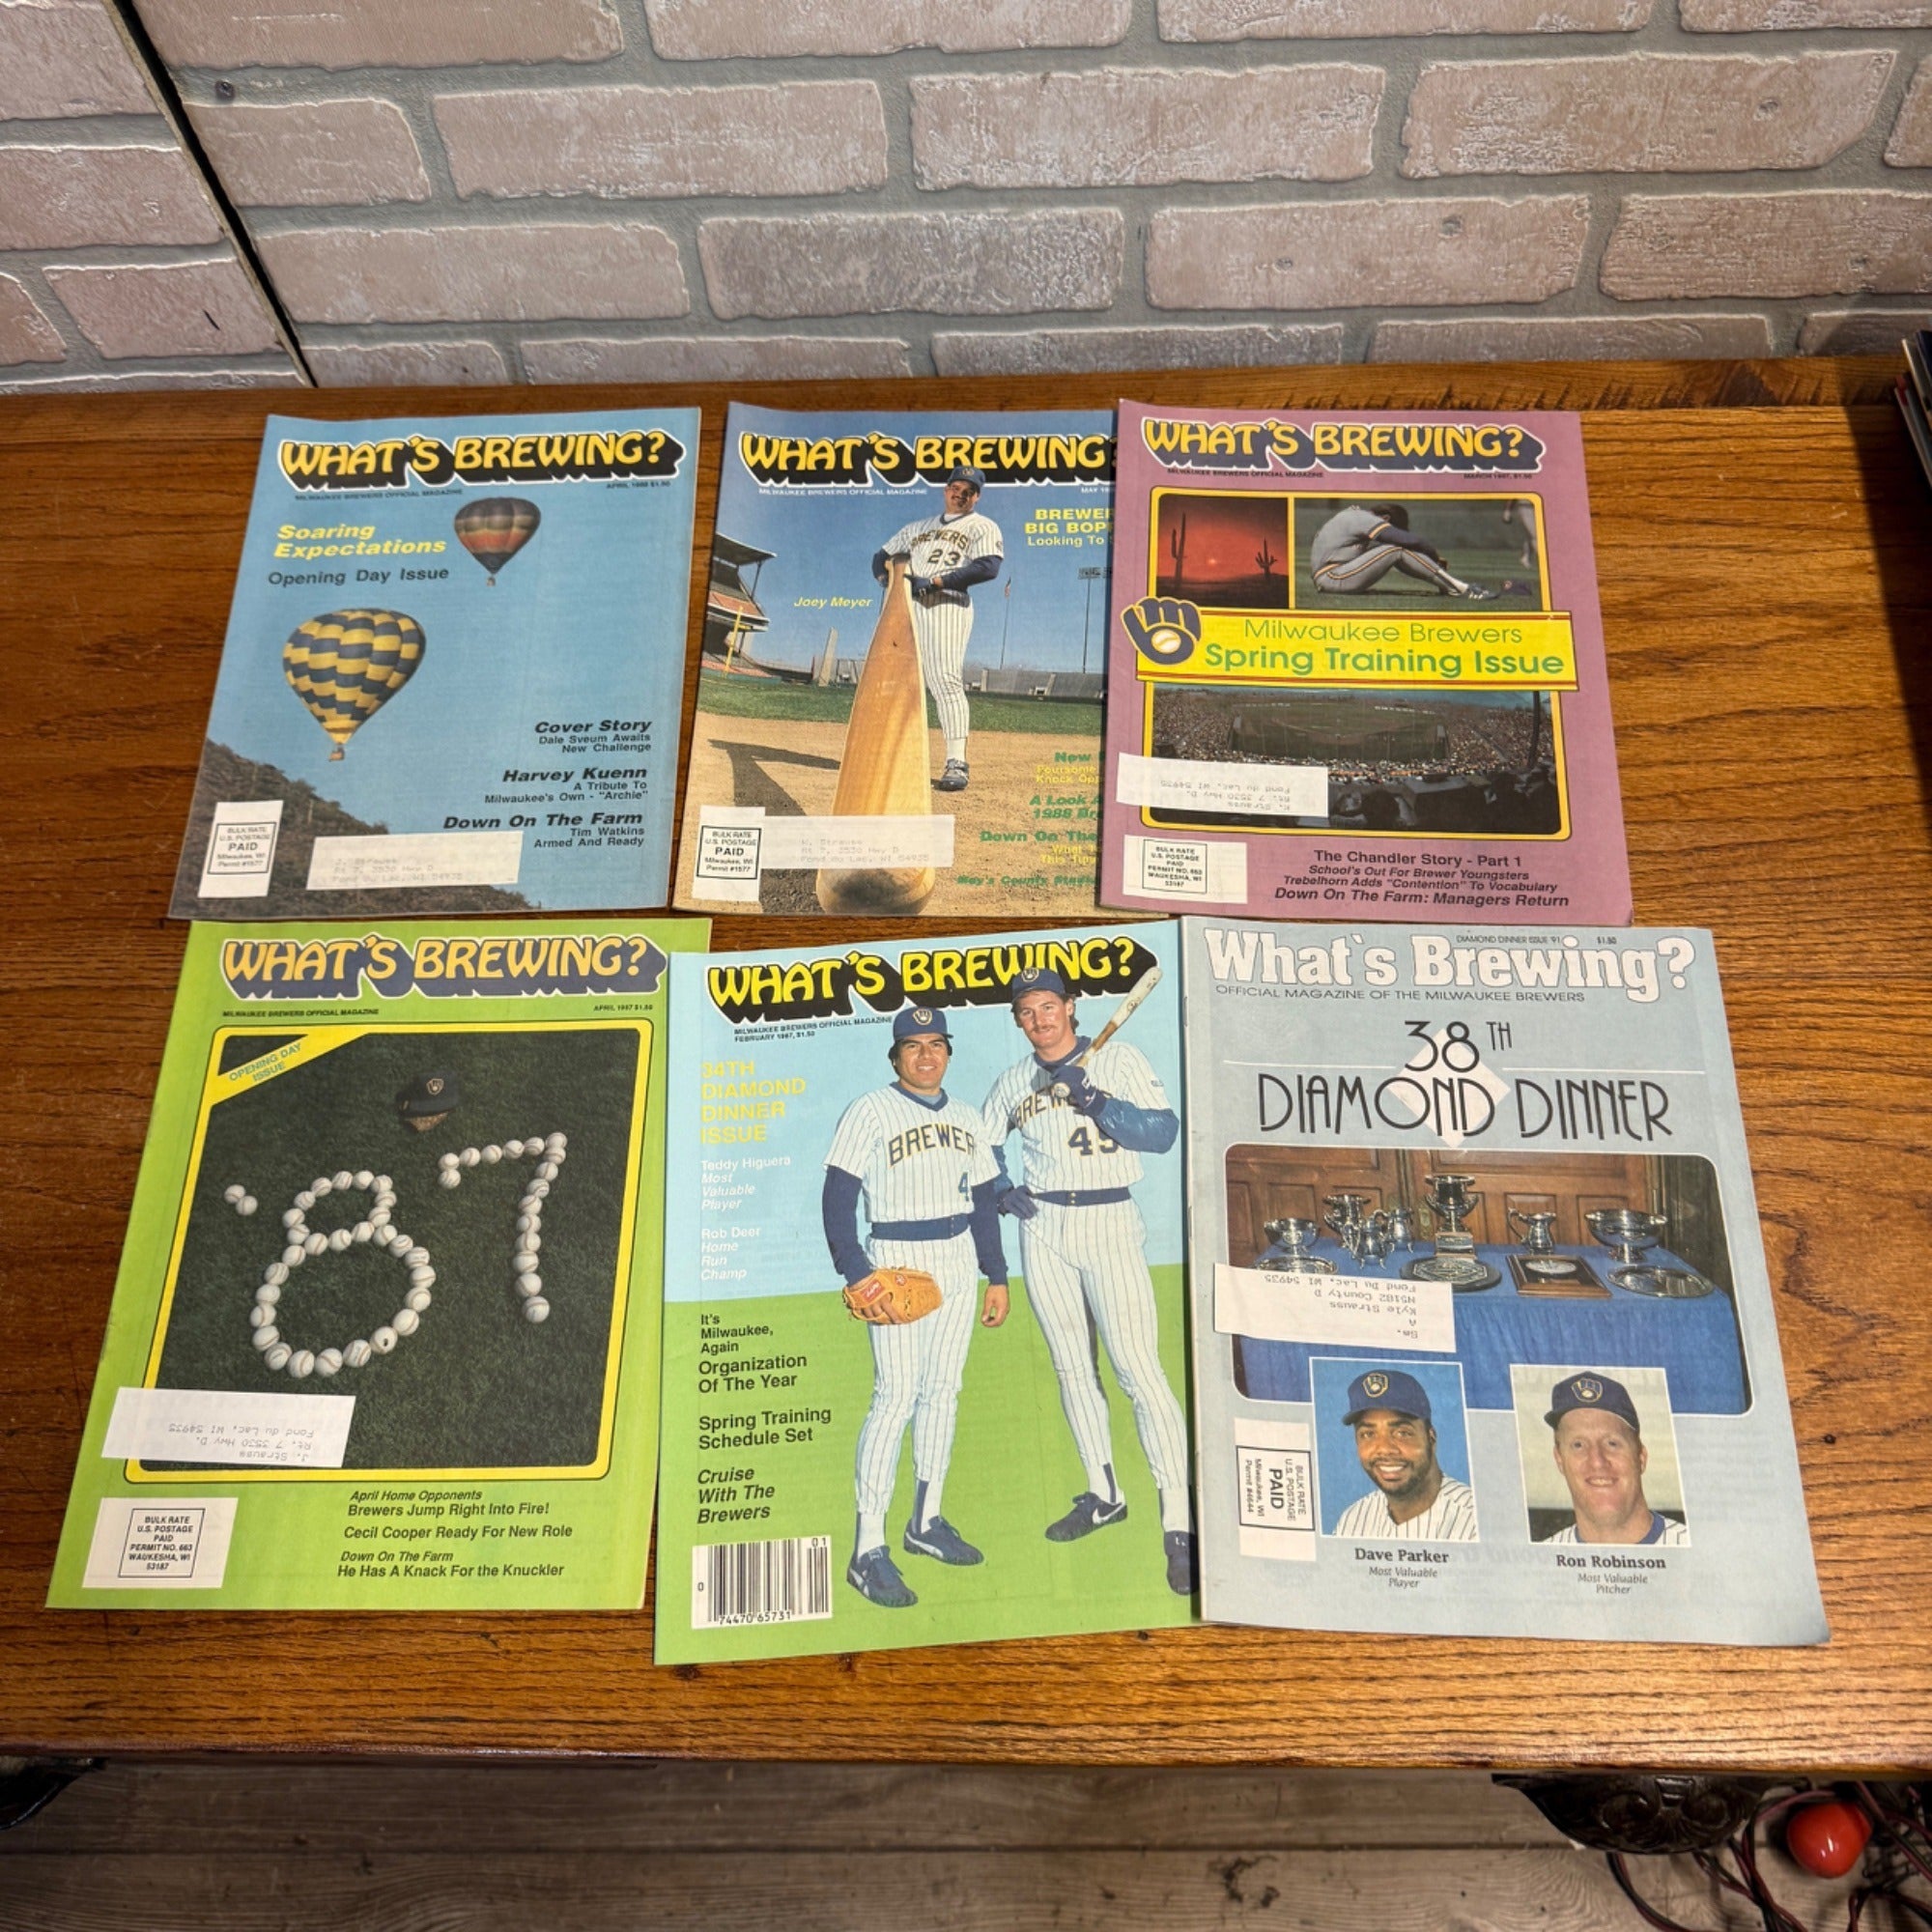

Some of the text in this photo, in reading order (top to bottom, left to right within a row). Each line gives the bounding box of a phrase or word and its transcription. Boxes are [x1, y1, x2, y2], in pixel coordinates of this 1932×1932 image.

[1145, 420, 1523, 457] WHAT'S BREWING?
[282, 430, 667, 477] WHAT'S BREWING?
[742, 433, 899, 470] WHAT'S
[277, 524, 376, 540] Soaring
[1025, 523, 1059, 533] BIG
[274, 539, 446, 559] Expectations
[1028, 535, 1104, 548] Looking To
[928, 549, 961, 566] 23
[269, 568, 448, 587] Opening Day Issue
[794, 597, 872, 610] Joey Meyer
[1244, 619, 1522, 643] Milwaukee Brewers
[1206, 642, 1564, 679] Spring Training Issue
[535, 720, 652, 733] Cover Story
[539, 733, 650, 745] Dale Sveum Awaits
[562, 743, 651, 753] New Challenge
[502, 767, 647, 782] Harvey Kuenn
[587, 781, 627, 790] Tribute
[485, 791, 648, 804] Milwaukee's Own "Archie"
[1047, 795, 1086, 805] Look
[443, 812, 642, 829] Down On The Farm
[1034, 809, 1071, 818] 1988
[570, 827, 644, 837] Tim Watkins
[980, 831, 1096, 841] Down On The
[228, 841, 258, 851] PAID
[534, 839, 572, 848] Armed
[608, 838, 643, 846] Ready
[716, 847, 744, 856] PAID
[1314, 850, 1521, 867] The Chandler Story Part 1
[1309, 865, 1529, 881] School's Out For Brewer Youngsters
[1284, 876, 1557, 893] Trebelhorn Adds "Contention" To Vocabulary
[1275, 888, 1569, 907] Down On The Farm: Managers Return
[224, 934, 647, 980] WHAT'S BREWING?
[709, 937, 1135, 1006] WHAT'S BREWING?
[1409, 934, 1695, 1003] Brewing?
[1216, 985, 1585, 1002] OFFICIAL MAGAZINE OF THE MILWAUKEE BREWERS
[1404, 1020, 1513, 1073] 38 TH
[229, 1042, 301, 1081] OPENING DAY
[252, 1063, 285, 1082] ISSUE
[701, 1061, 755, 1079] 34TH
[701, 1078, 807, 1100] DIAMOND
[701, 1101, 785, 1122] DINNER
[1259, 1073, 1672, 1142] DIAMOND DINNER
[701, 1124, 767, 1145] ISSUE
[701, 1155, 791, 1172] Teddy Higuera
[701, 1174, 732, 1183] Most
[702, 1183, 756, 1197] Valuable
[702, 1199, 742, 1212] Player
[701, 1227, 761, 1240] Rob Deer
[701, 1242, 738, 1253] Home
[701, 1256, 727, 1266] Run
[701, 1269, 748, 1281] Champ
[701, 1314, 720, 1325] It's
[701, 1325, 773, 1339] Milwaukee,
[700, 1342, 739, 1355] Again
[699, 1355, 807, 1376] Organization
[698, 1375, 797, 1393] Of The Year
[699, 1407, 832, 1433] Spring Training
[699, 1428, 813, 1450] Schedule Set
[697, 1467, 754, 1484] Cruise
[350, 1491, 482, 1502] April Home Opponents
[698, 1485, 775, 1504] With The
[1269, 1468, 1284, 1509] PAID
[348, 1502, 549, 1519] Brewers Jump Right Into Fire!
[697, 1506, 771, 1524] Brewers
[344, 1525, 572, 1541] Cecil Cooper Ready For New Role
[341, 1551, 453, 1561] Down On The Farm
[1355, 1548, 1449, 1563] Dave Parker
[1556, 1555, 1665, 1569] Ron Robinson
[338, 1564, 564, 1577] He Has A Knack For the Knuckler
[1369, 1566, 1437, 1577] Most Valuable
[1388, 1577, 1420, 1589] Player
[1577, 1574, 1648, 1584] Most Valuable
[1597, 1584, 1631, 1594] Pitcher
[719, 1611, 791, 1625] 74470 65731
